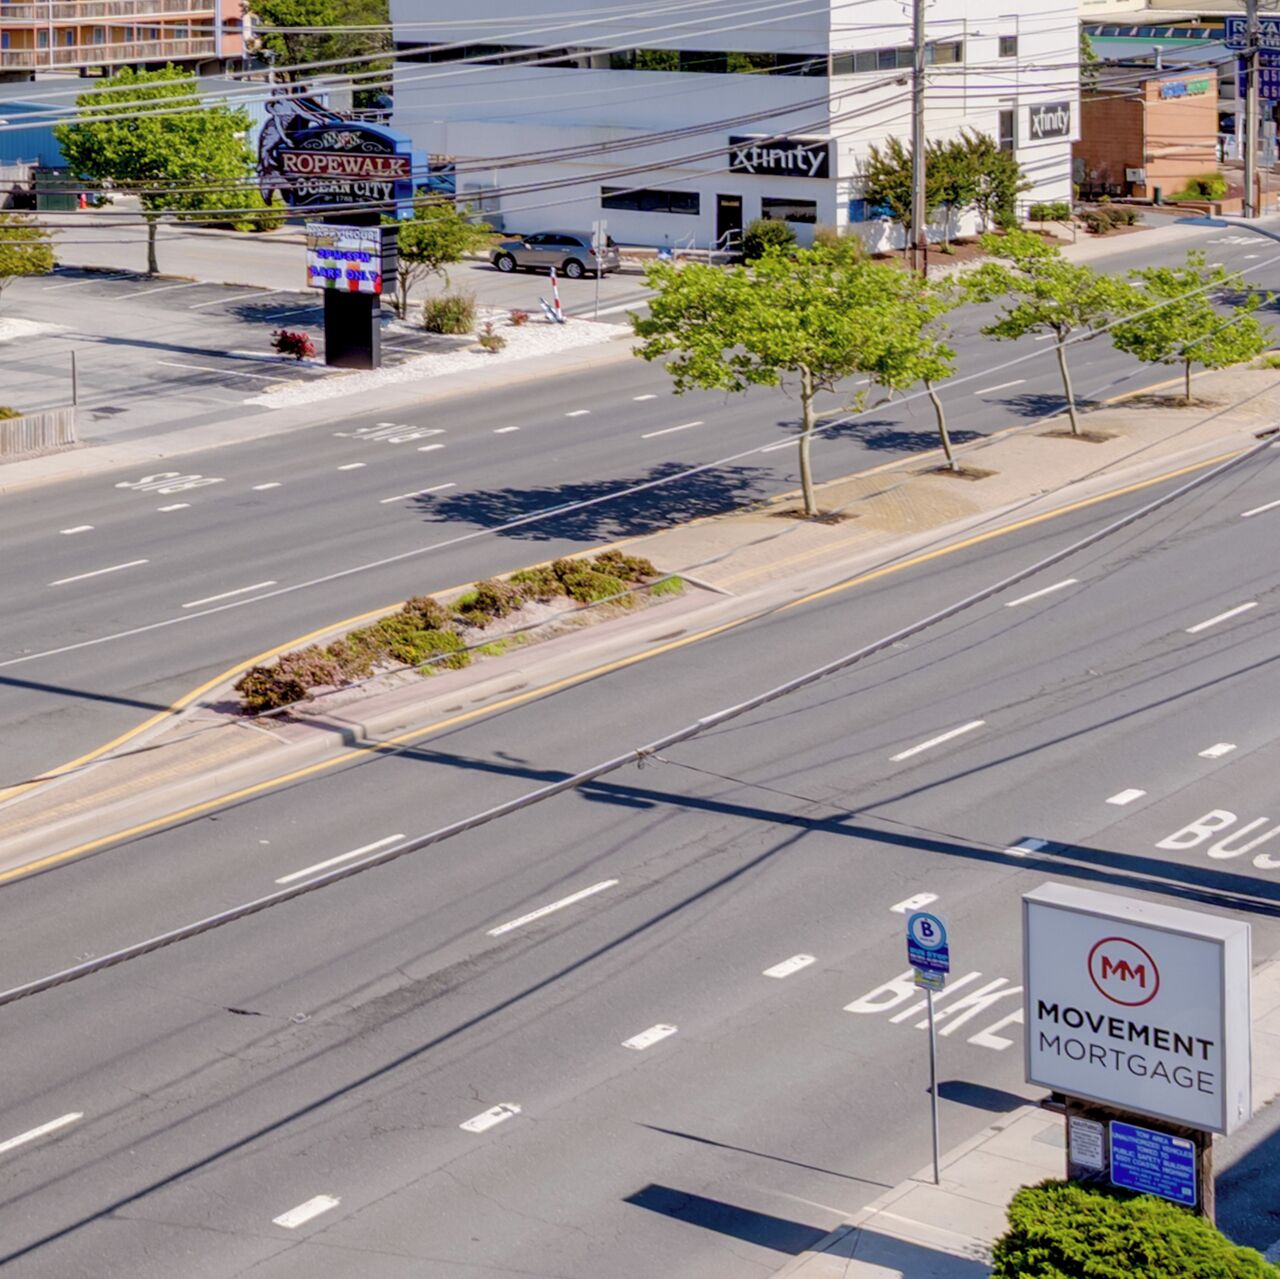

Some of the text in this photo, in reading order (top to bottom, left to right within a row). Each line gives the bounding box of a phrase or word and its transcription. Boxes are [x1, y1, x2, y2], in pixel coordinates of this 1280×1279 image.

[1032, 107, 1071, 137] xfinity
[282, 153, 406, 176] ROPEWALK
[733, 144, 826, 176] xfinity
[297, 178, 393, 201] OCEAN CITY
[921, 920, 934, 937] B
[1038, 999, 1215, 1061] MOVEMENT
[1040, 1031, 1215, 1095] MORTGAGE
